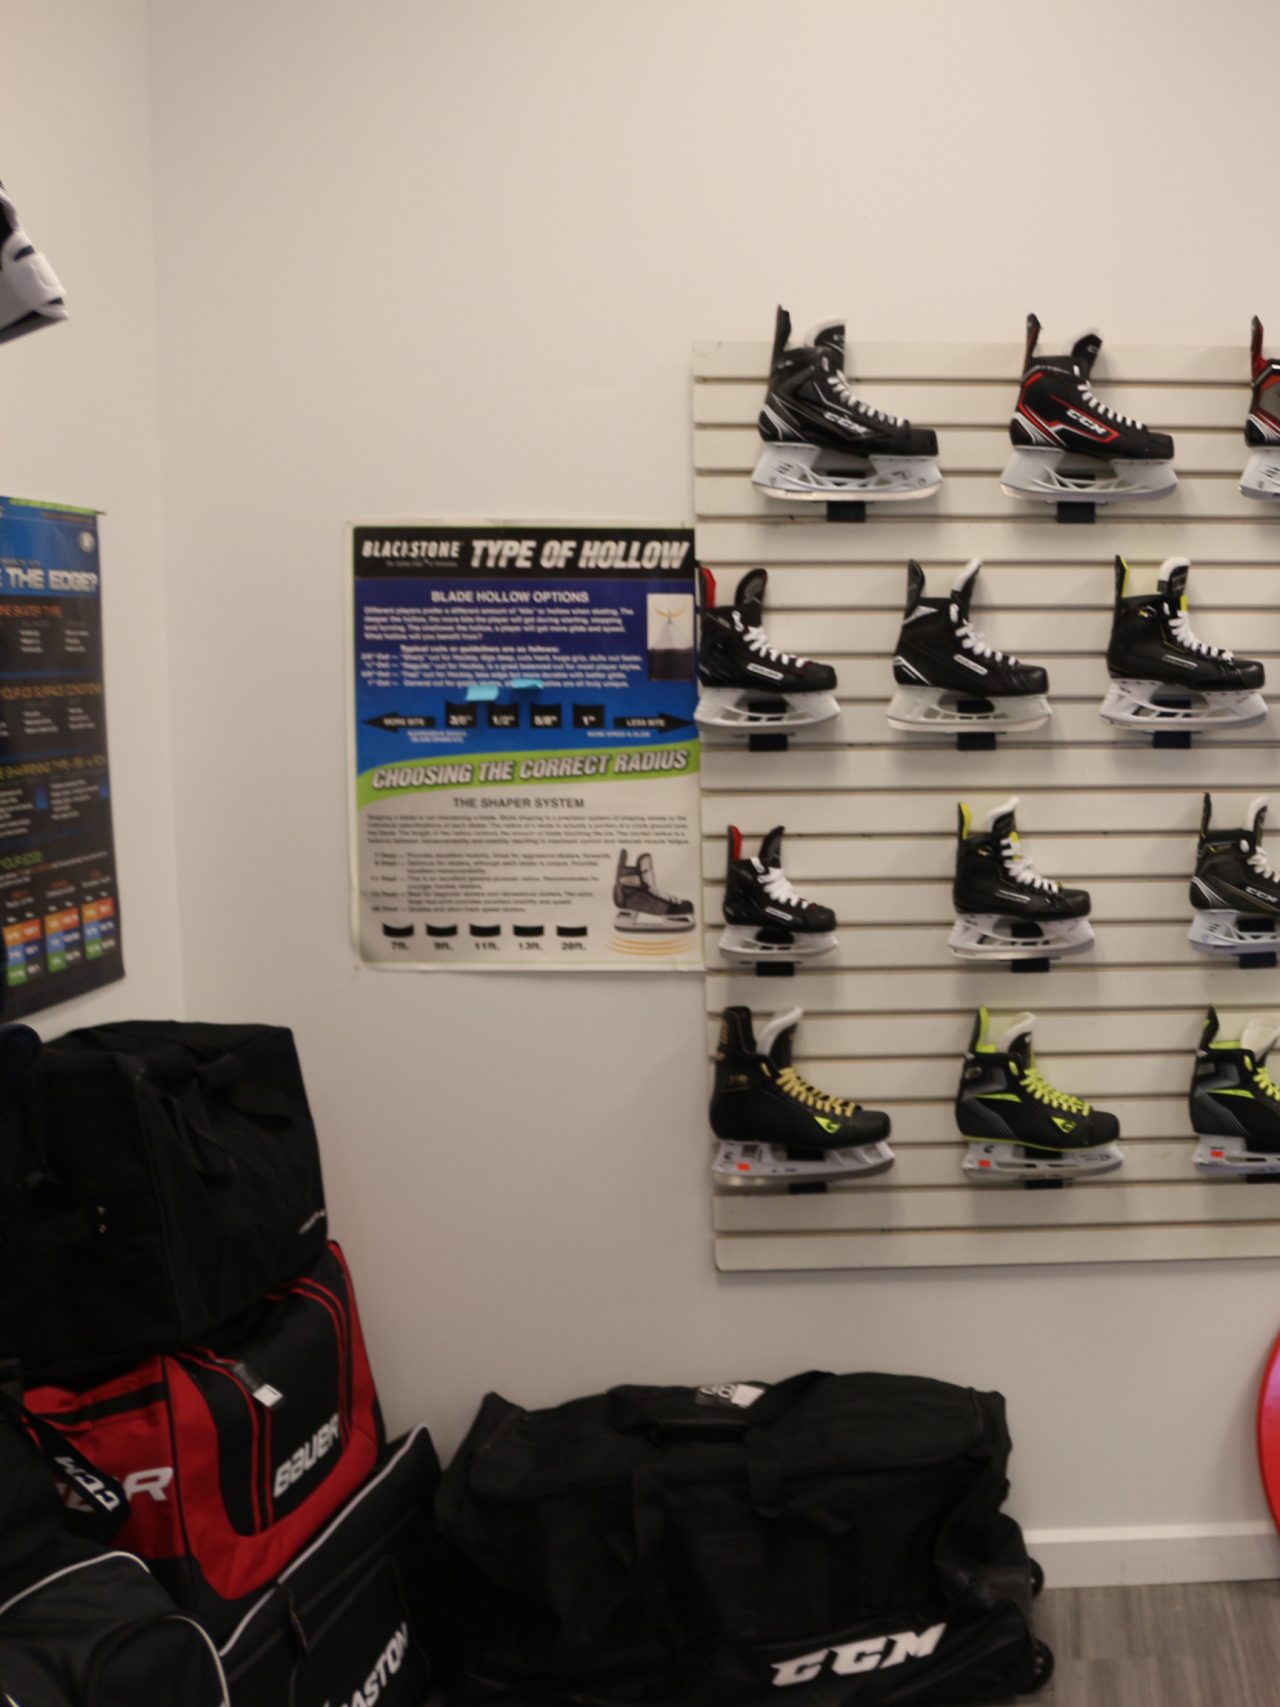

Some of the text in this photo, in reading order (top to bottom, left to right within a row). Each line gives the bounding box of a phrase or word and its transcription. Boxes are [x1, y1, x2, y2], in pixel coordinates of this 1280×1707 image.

[823, 411, 869, 434] CCM
[1066, 409, 1106, 435] CCM
[362, 540, 690, 569] BLACKSTONE TYPE OF HOLLOW
[5, 567, 44, 590] THE
[431, 591, 590, 603] BLADE HOLLOW OPTIONS
[372, 749, 688, 789] CHOOSING THE CORRECT RADIUS
[453, 798, 585, 809] THE SHAPER SYSTEM
[273, 1412, 340, 1498] BAUER
[54, 1456, 120, 1512] CCM
[323, 1621, 408, 1707] ASTON
[770, 1622, 947, 1687] CCM
